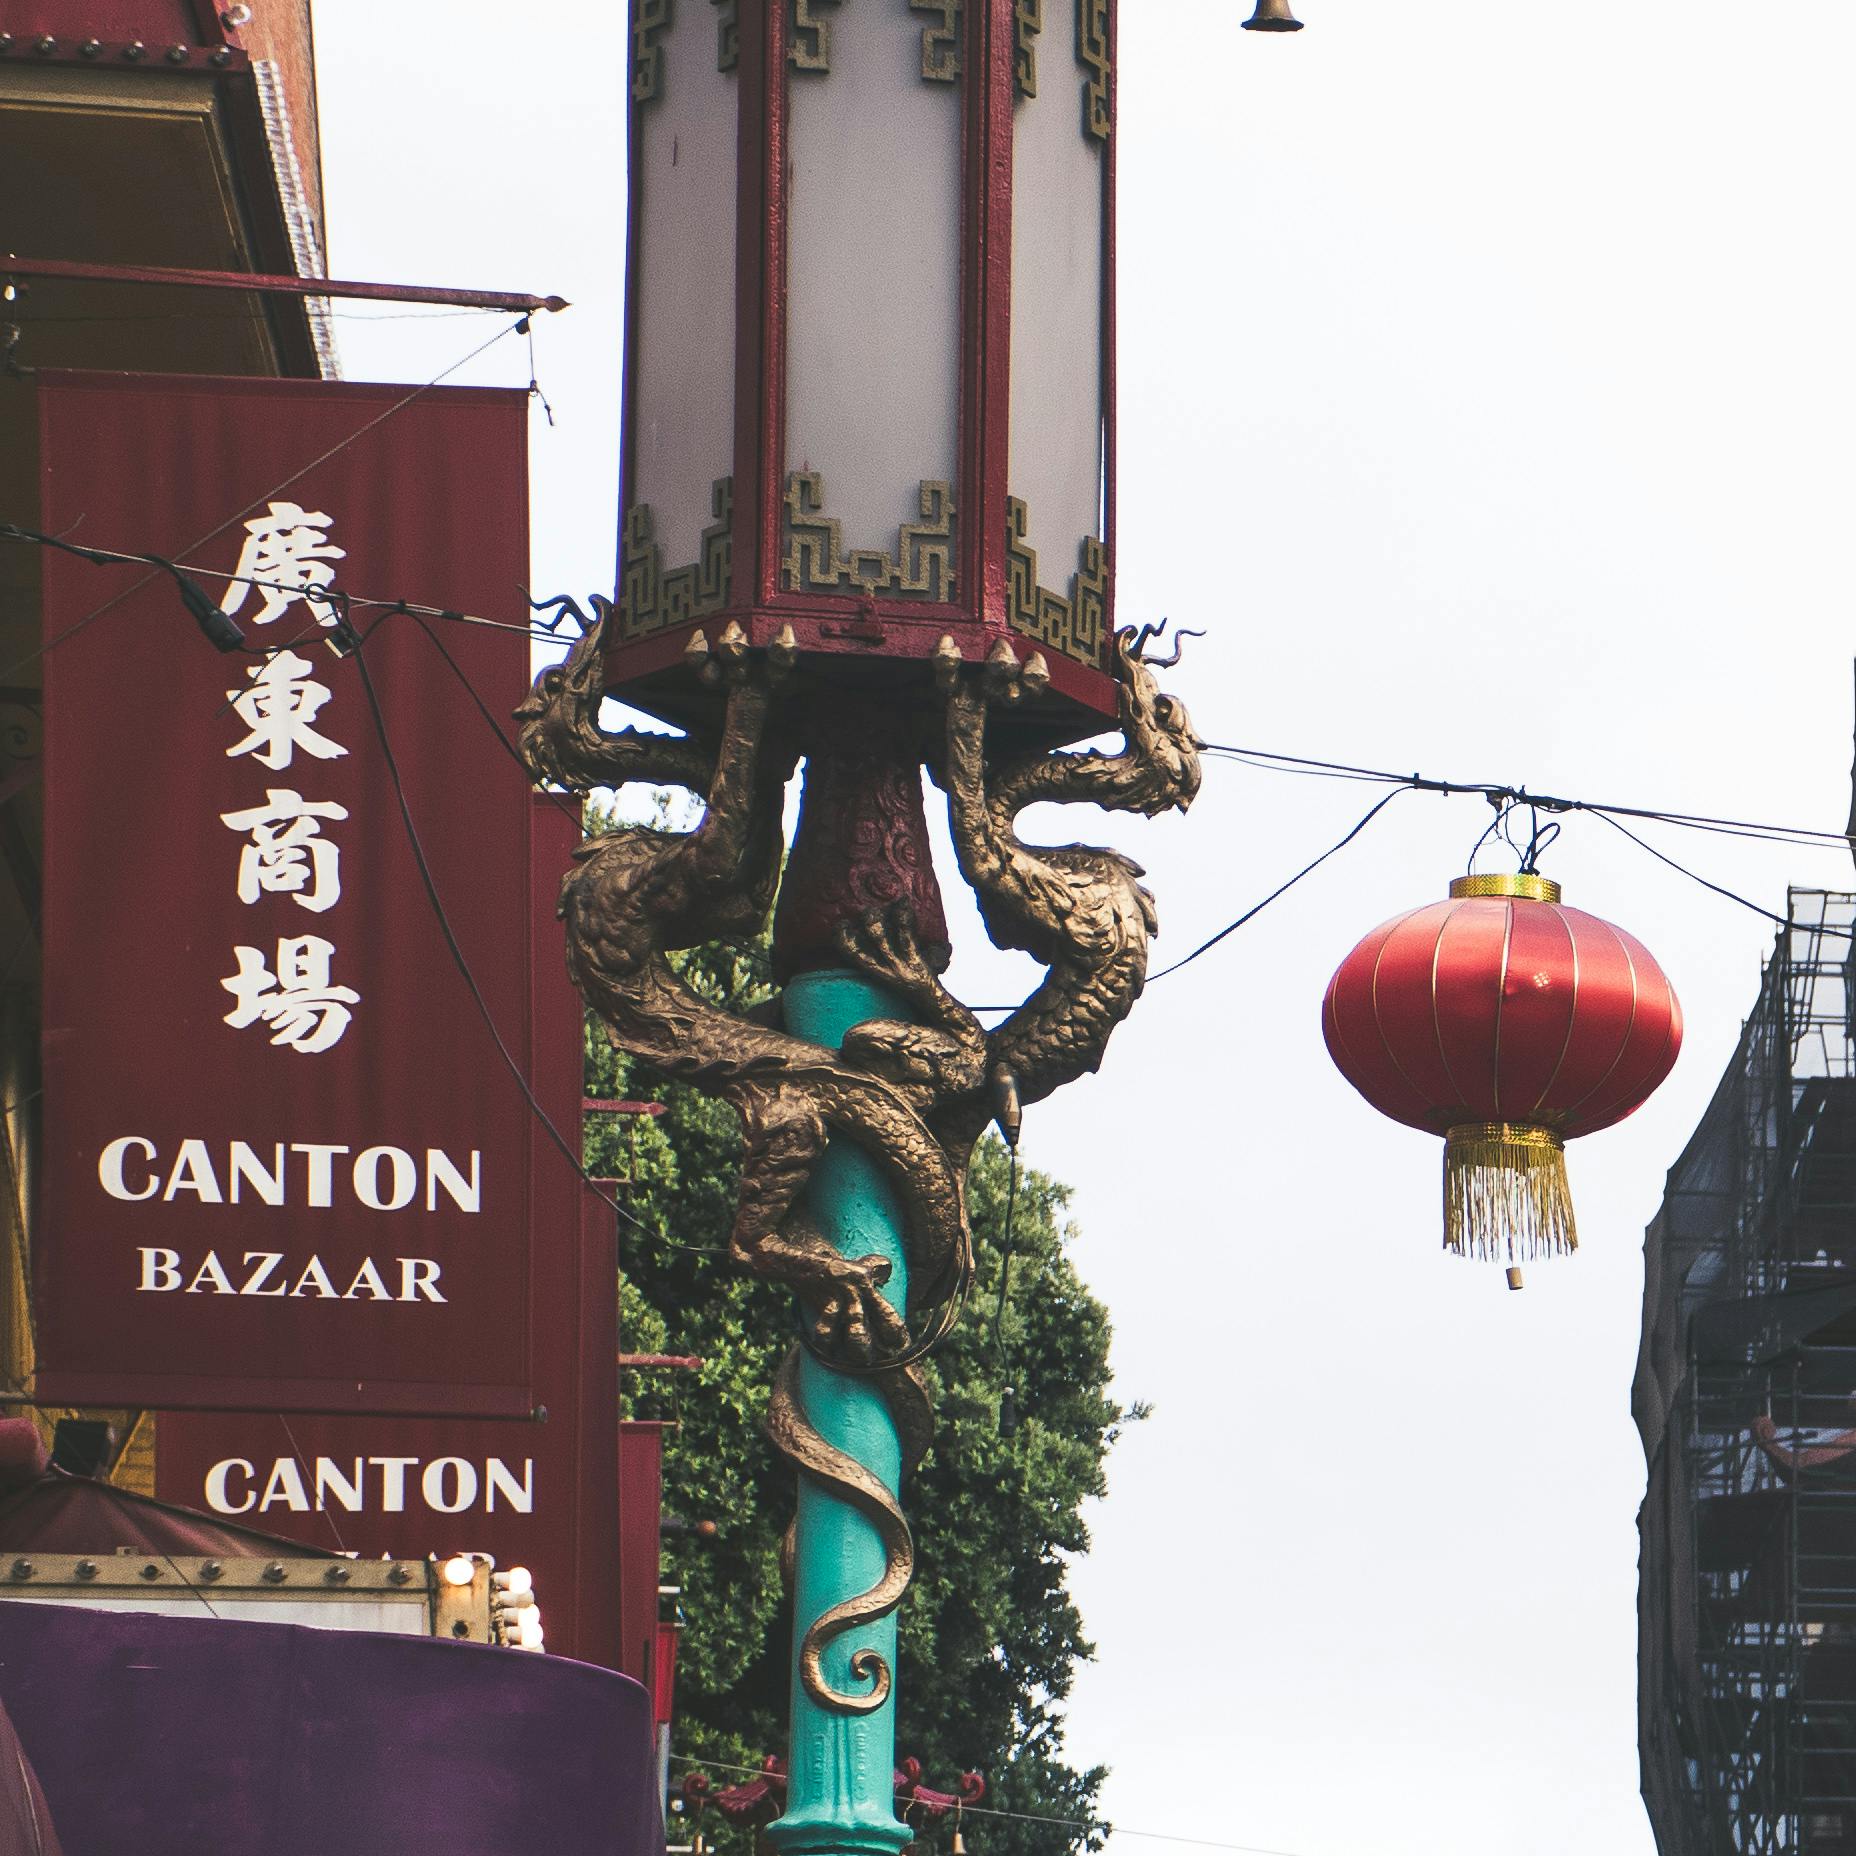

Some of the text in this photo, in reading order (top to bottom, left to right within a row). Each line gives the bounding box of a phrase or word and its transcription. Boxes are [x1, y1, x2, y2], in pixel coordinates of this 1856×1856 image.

[219, 501, 360, 1054] 廣東商場
[98, 1136, 482, 1213] CANTON
[136, 1247, 449, 1304] BAZAAR
[204, 1457, 534, 1514] CANTON
